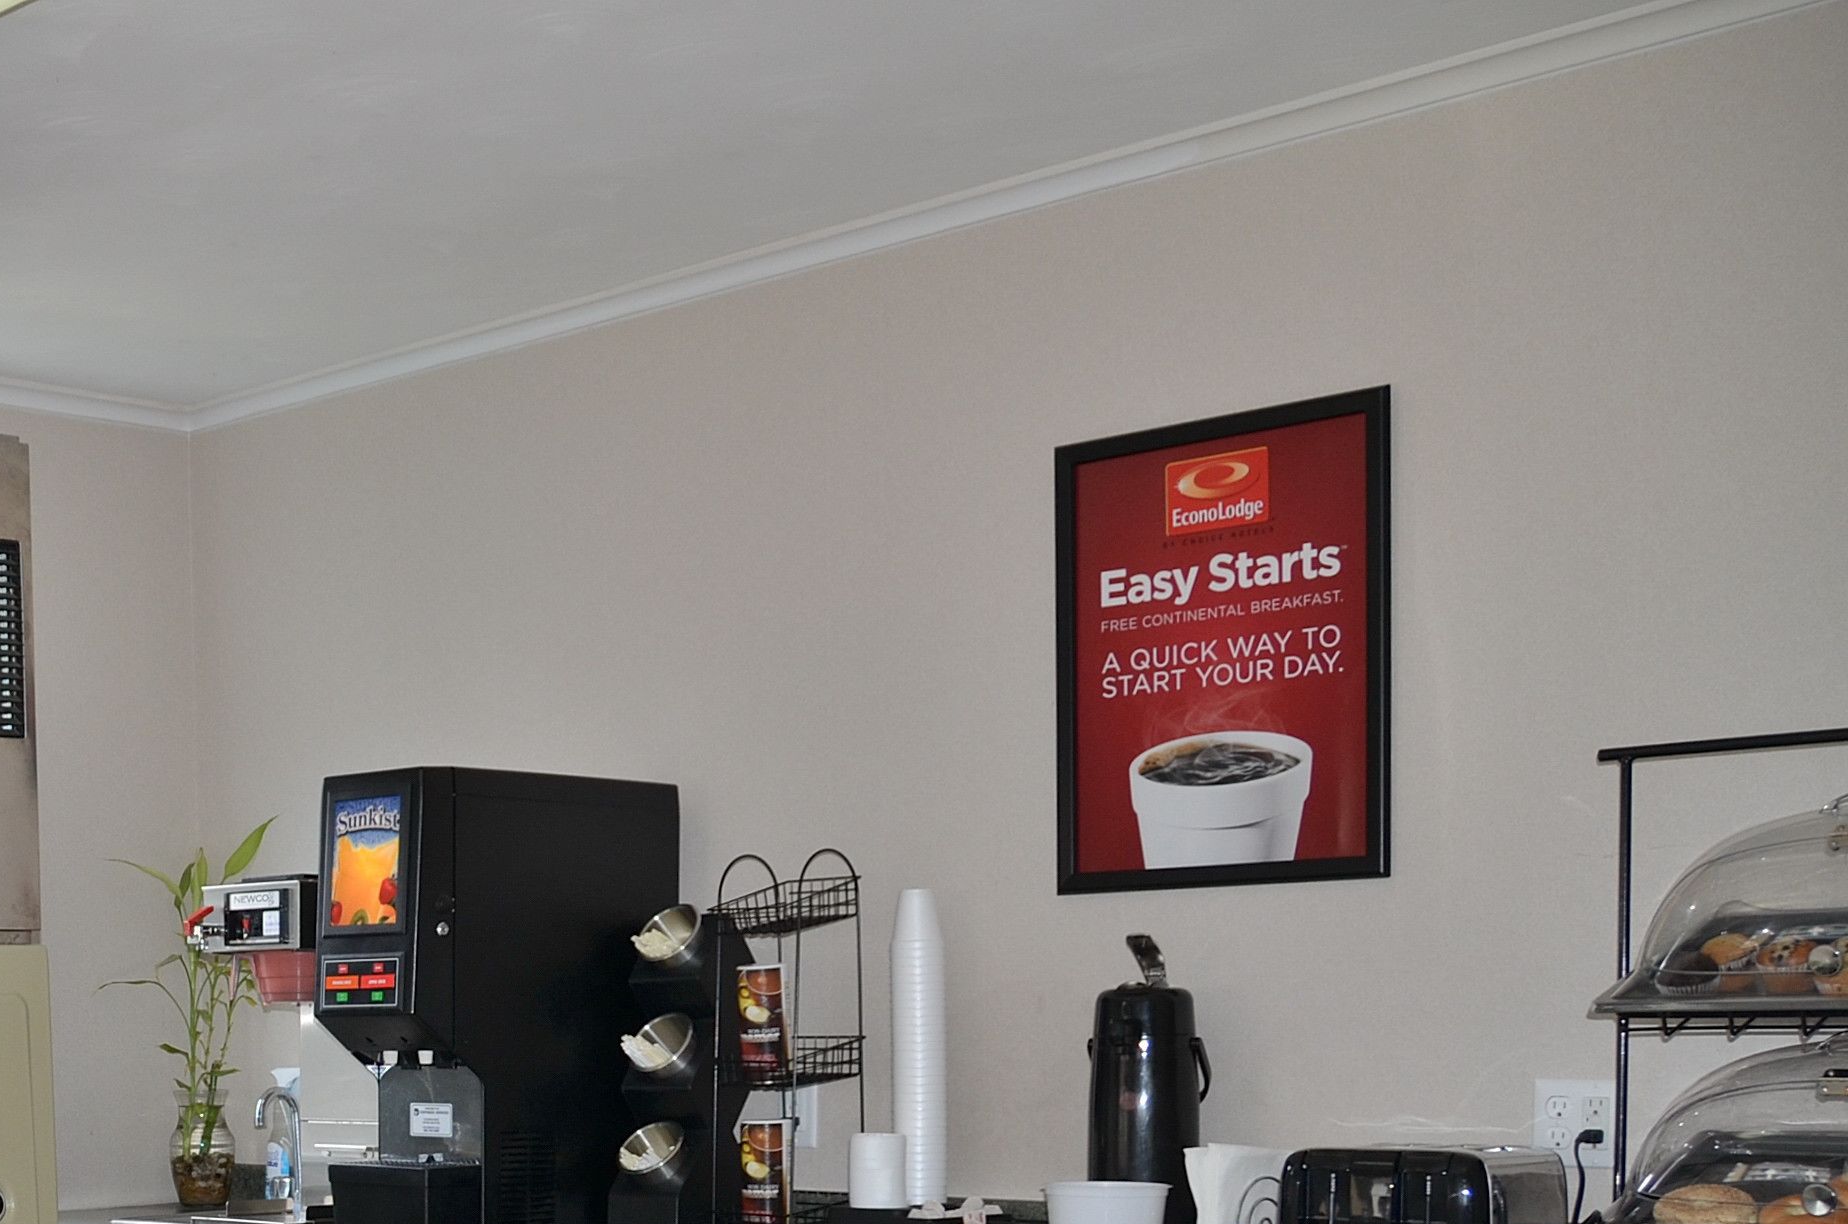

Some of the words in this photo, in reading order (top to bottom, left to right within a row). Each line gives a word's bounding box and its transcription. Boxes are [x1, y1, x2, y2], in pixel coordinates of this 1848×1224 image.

[1172, 498, 1264, 528] EconoLodge
[1100, 566, 1199, 608] Easy
[1101, 617, 1137, 633] FREE
[1142, 604, 1245, 628] CONTINENTAL
[1250, 590, 1344, 614] BREAKFAST.
[1101, 652, 1121, 674] A
[1130, 639, 1218, 670] QUICK
[1227, 630, 1293, 659] WAY
[1302, 624, 1341, 650] TO
[1101, 668, 1186, 699] START
[1196, 658, 1274, 687] YOUR
[1283, 650, 1344, 680] DAY.
[336, 805, 400, 836] Sunkist
[234, 894, 270, 906] NEWCO
